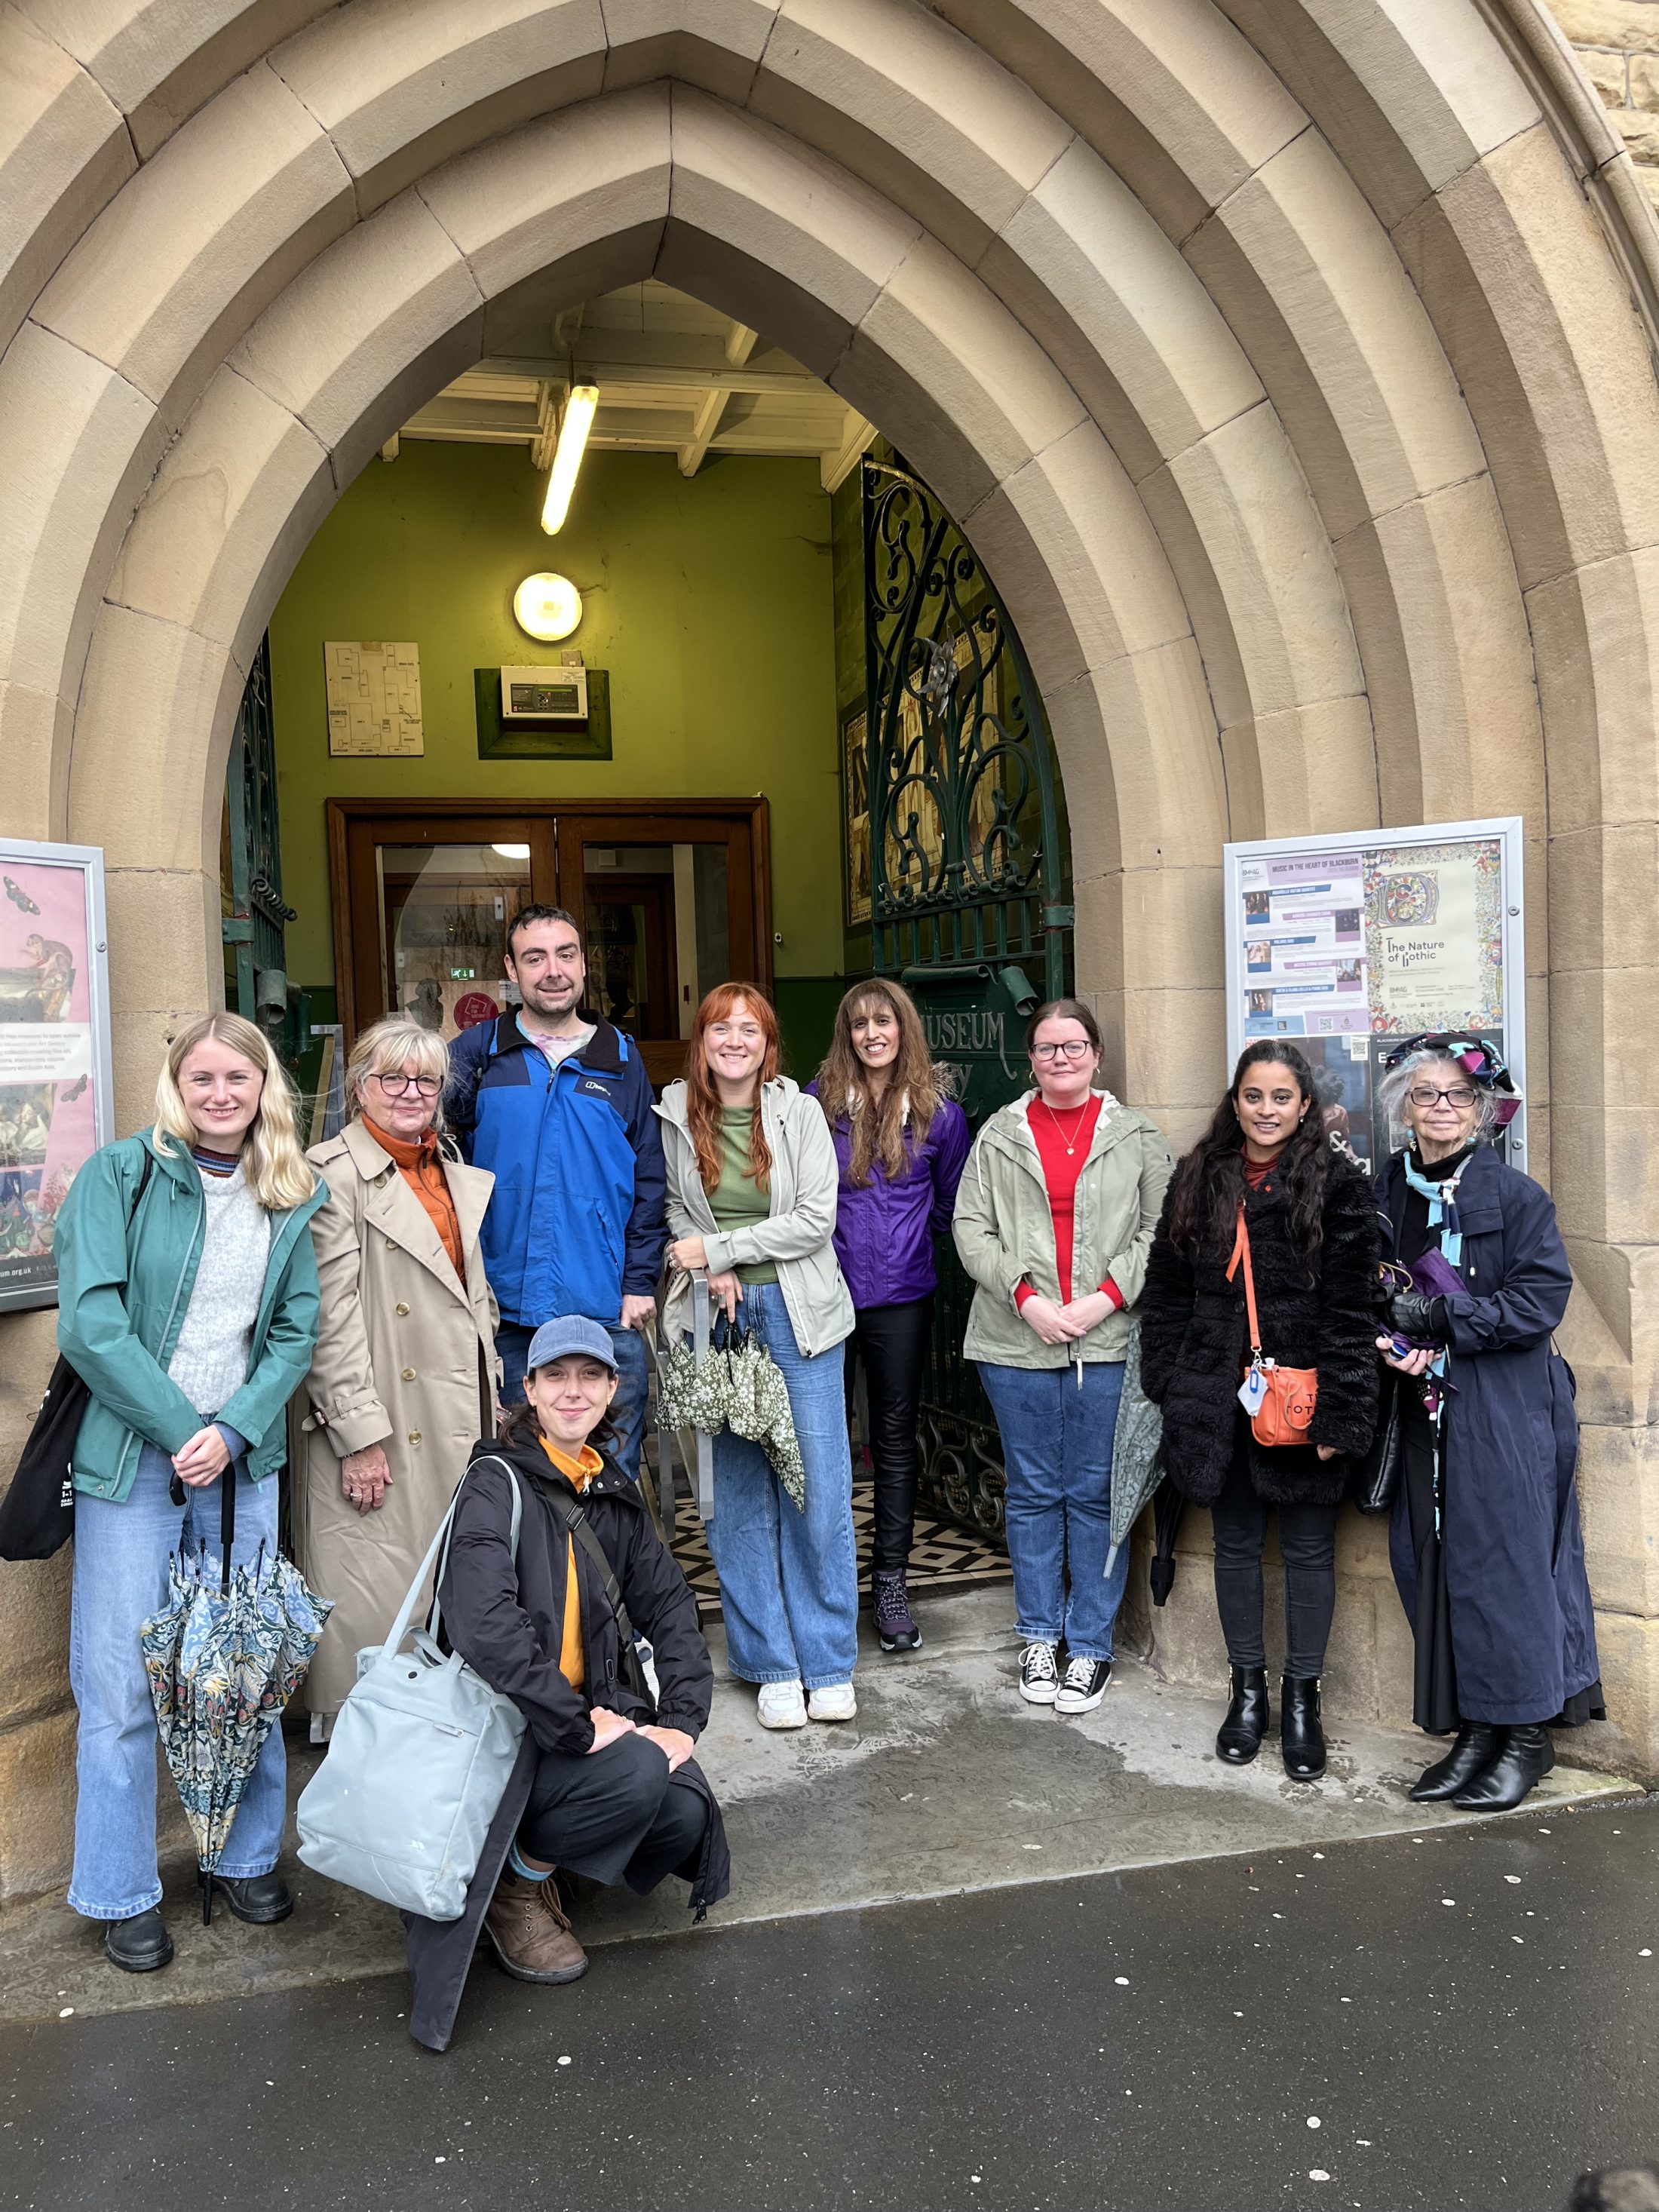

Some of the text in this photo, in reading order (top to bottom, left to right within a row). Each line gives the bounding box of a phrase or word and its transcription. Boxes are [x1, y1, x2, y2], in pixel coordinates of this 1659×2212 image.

[1329, 858, 1359, 867] BLACKBURN
[1386, 937, 1445, 953] The Nature
[1388, 953, 1399, 962] of
[1378, 1051, 1388, 1063] E
[1329, 1130, 1348, 1152] &
[0, 1266, 32, 1278] um.org.uk
[1286, 1405, 1314, 1415] TOT
